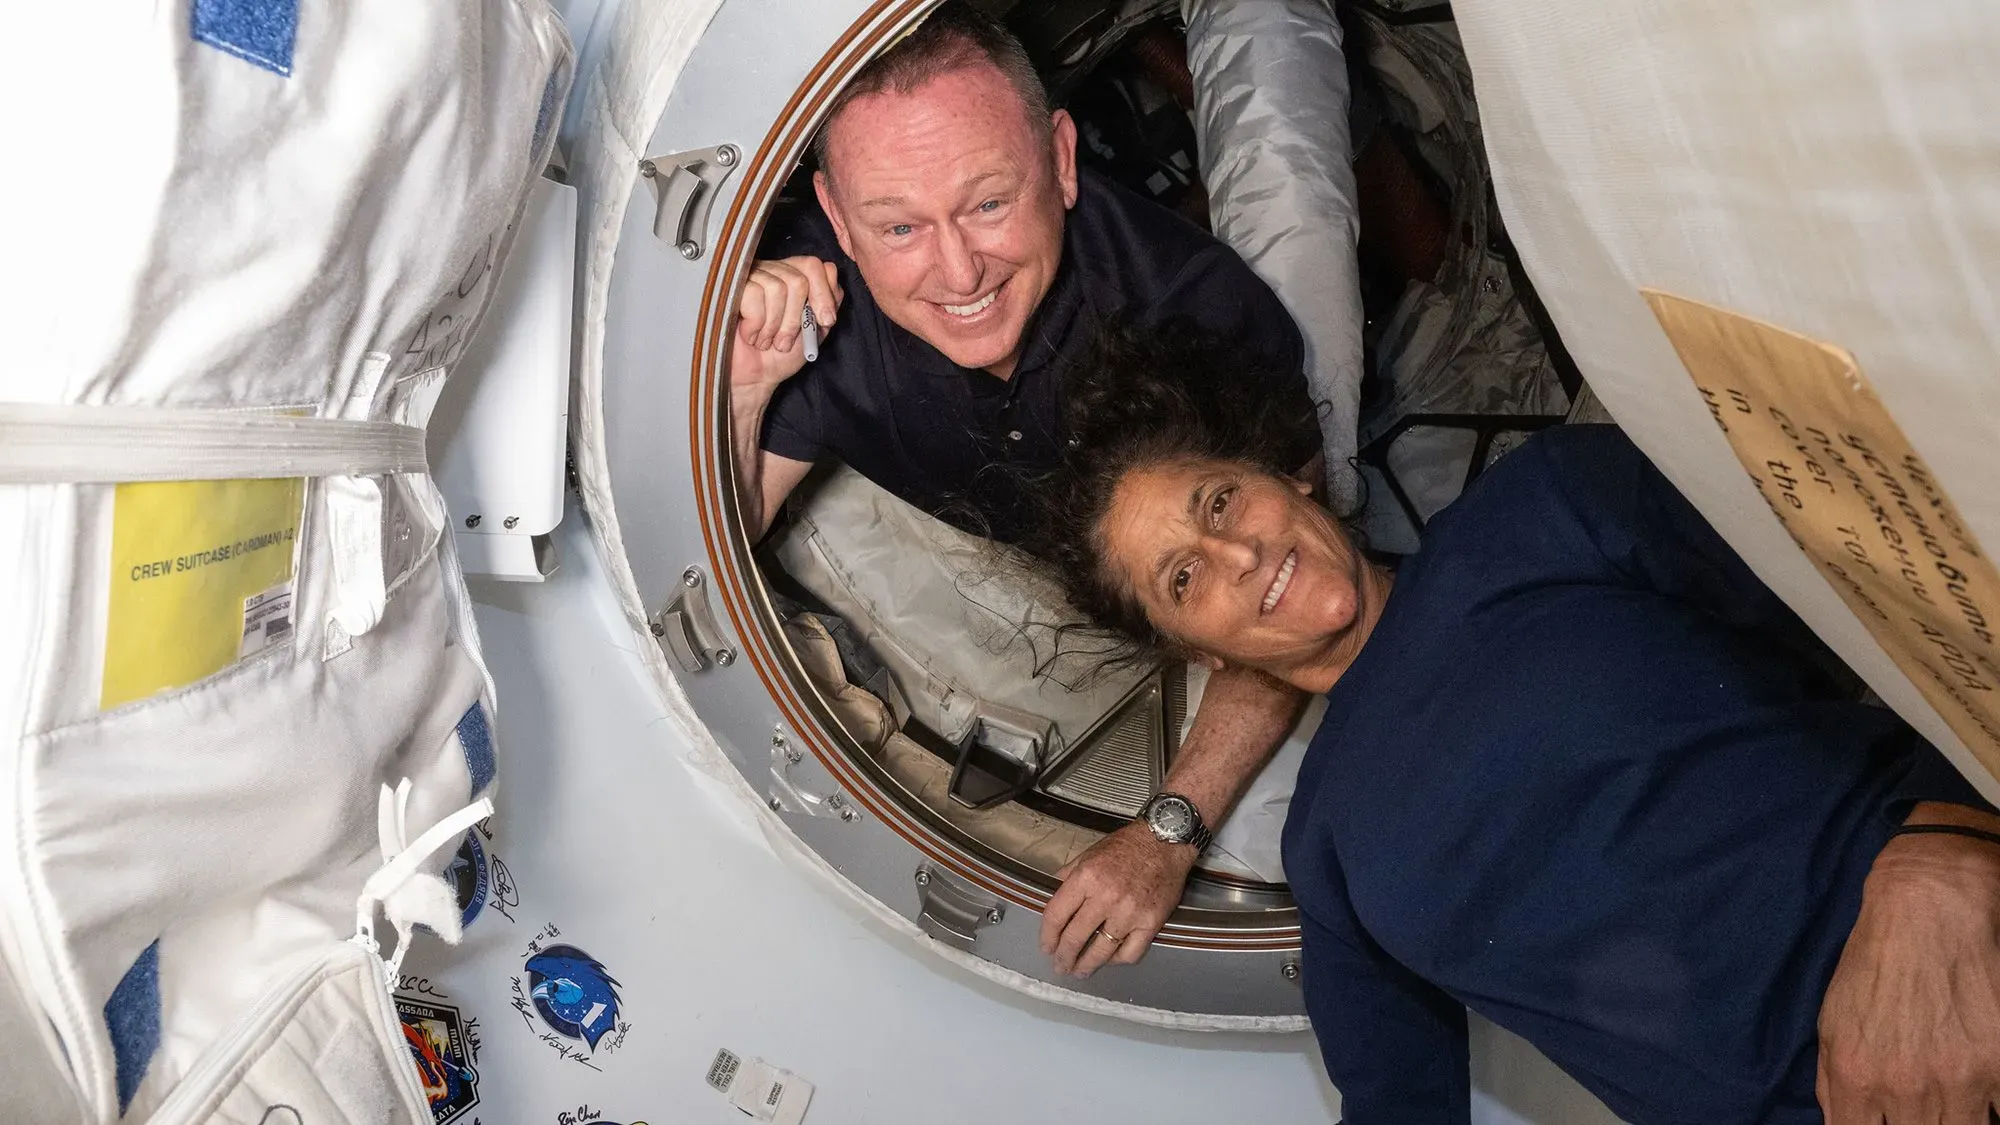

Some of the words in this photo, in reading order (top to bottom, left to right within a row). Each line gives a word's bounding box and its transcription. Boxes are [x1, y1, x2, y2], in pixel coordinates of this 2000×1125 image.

[1726, 388, 1752, 414] in
[1767, 460, 1803, 510] the
[131, 559, 173, 581] CREW
[176, 545, 231, 572] SUITCASE
[475, 863, 488, 905] ФЕДЯЕВ
[395, 1003, 434, 1018] ASSADA
[709, 1051, 727, 1081] RESTRAINT
[721, 1055, 733, 1074] WATER
[727, 1060, 739, 1074] FUEL
[713, 1073, 724, 1087] LINE
[721, 1074, 732, 1088] CELL
[434, 1104, 456, 1123] KATA
